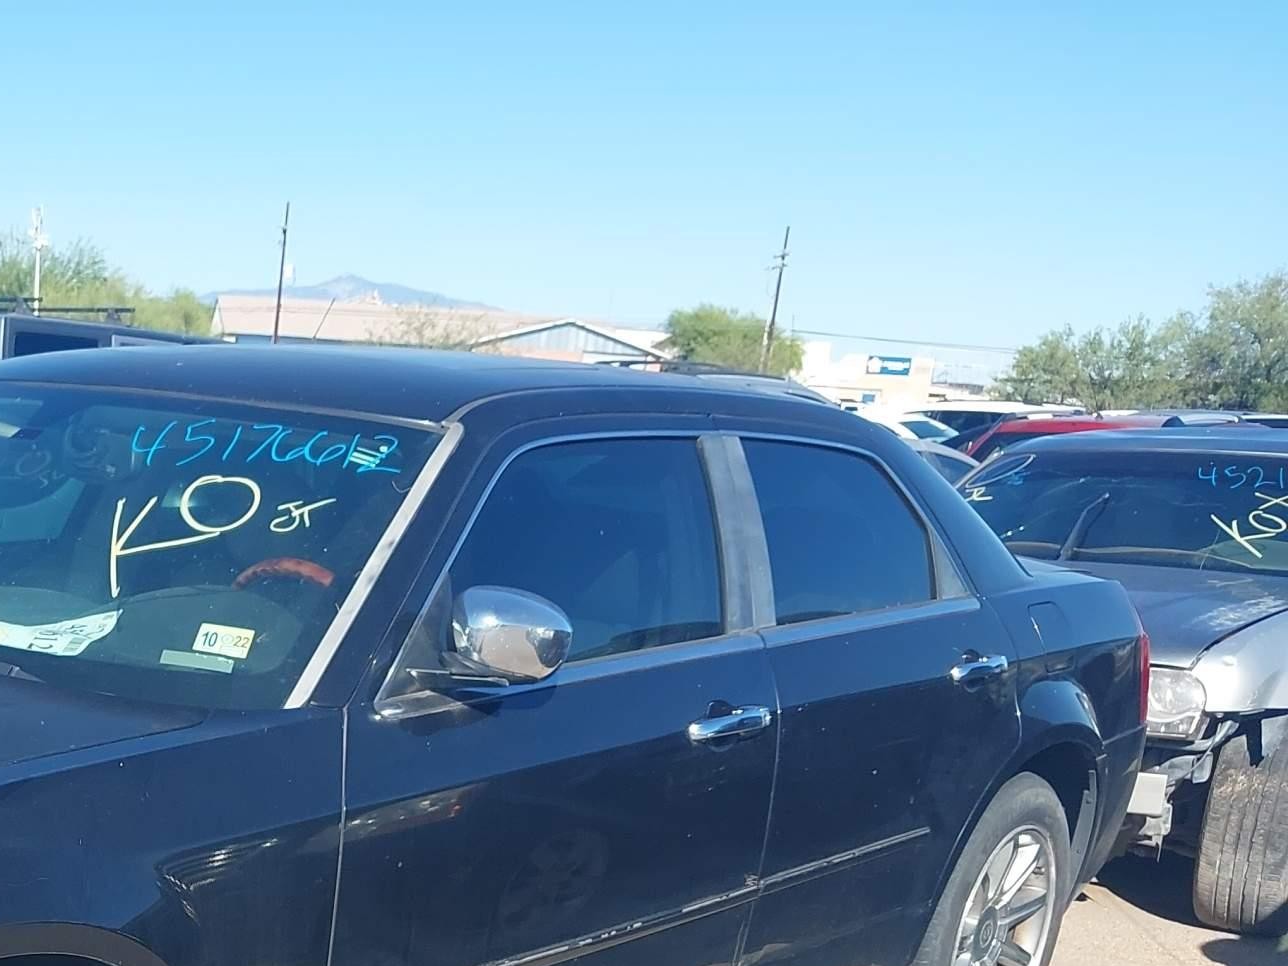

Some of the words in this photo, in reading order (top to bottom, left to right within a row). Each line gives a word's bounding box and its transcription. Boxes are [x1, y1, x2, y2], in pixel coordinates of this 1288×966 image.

[111, 475, 261, 598] KO
[201, 631, 218, 648] 10
[232, 635, 250, 649] 22
